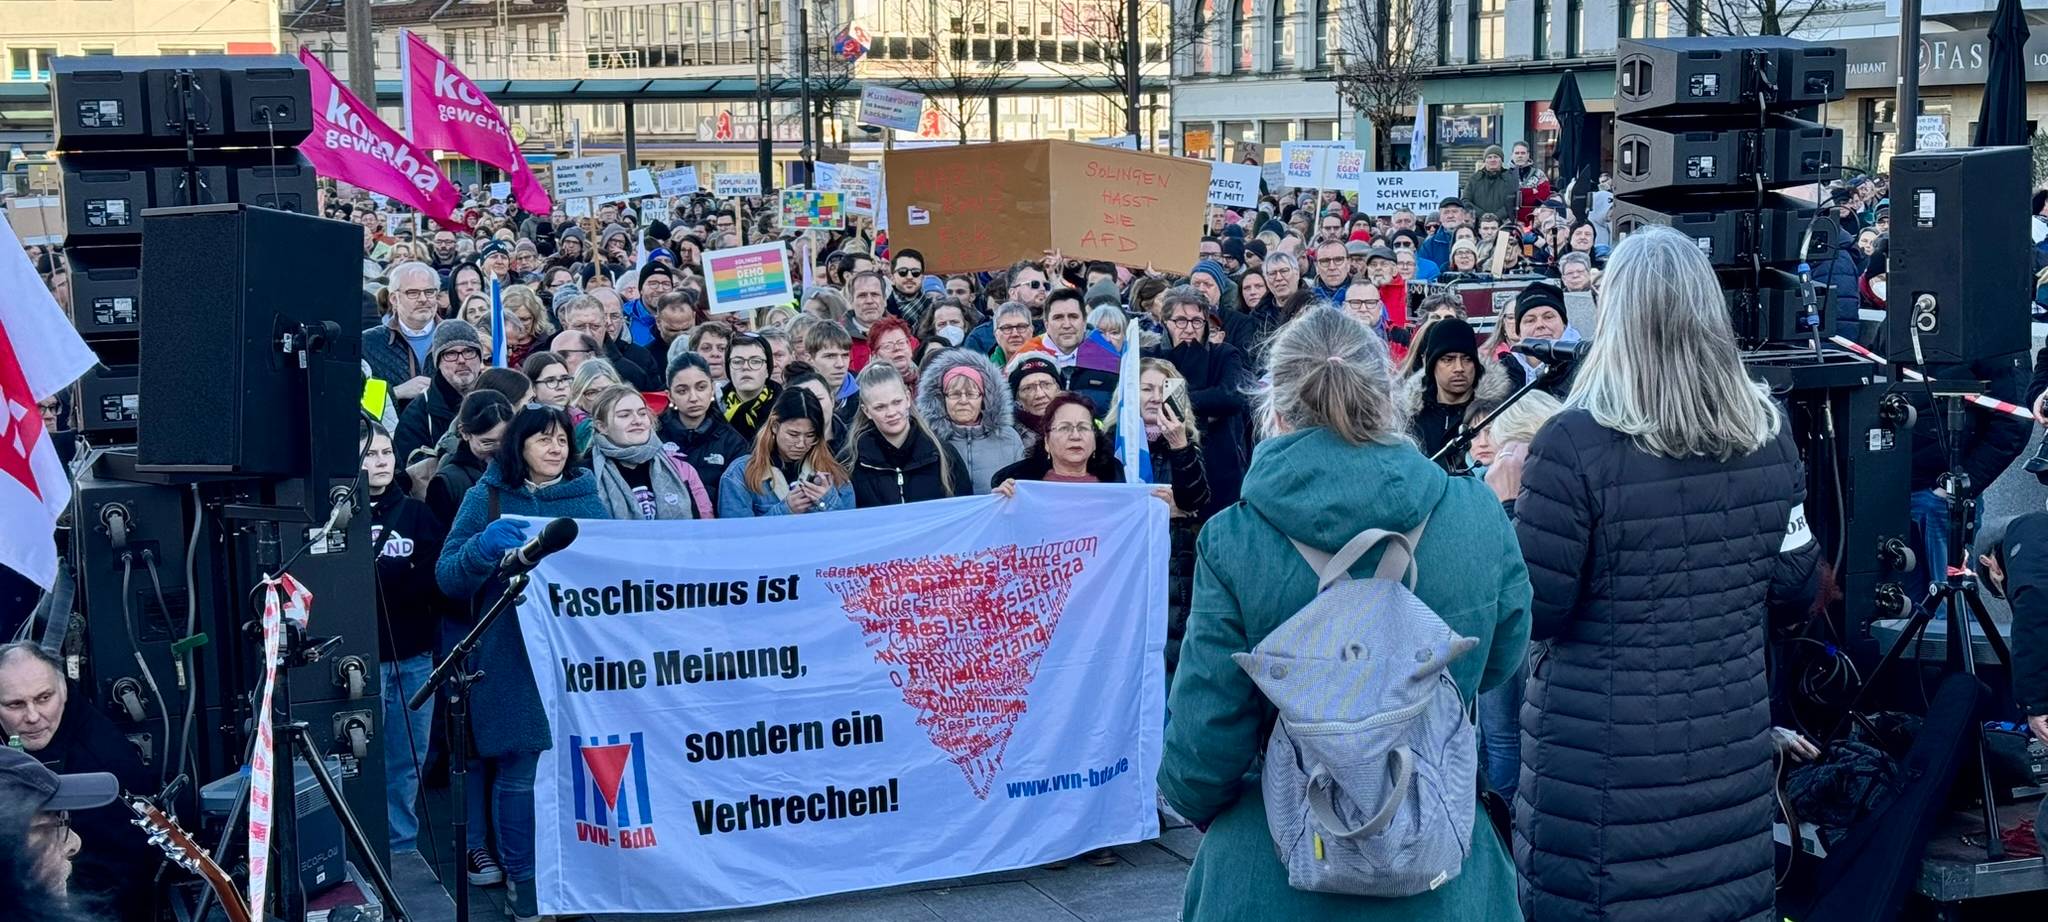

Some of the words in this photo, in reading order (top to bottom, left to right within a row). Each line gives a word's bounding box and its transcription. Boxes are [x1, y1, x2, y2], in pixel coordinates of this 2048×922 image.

[1376, 177, 1404, 186] WER
[1102, 189, 1159, 208] HASST
[1224, 192, 1244, 202] MIT!
[1376, 189, 1439, 199] SCHWEIGT,
[1376, 202, 1416, 211] MACHT
[1104, 213, 1136, 227] DIE
[1080, 230, 1138, 252] AFD
[737, 266, 764, 279] DEMO
[547, 577, 749, 618] Faschismus
[756, 573, 801, 604] ist
[562, 656, 647, 693] keine
[653, 644, 807, 687] Meinung,
[685, 719, 825, 763] sondern
[831, 710, 884, 748] ein
[692, 777, 899, 836] Verbrechen!
[619, 826, 657, 849] BdA
